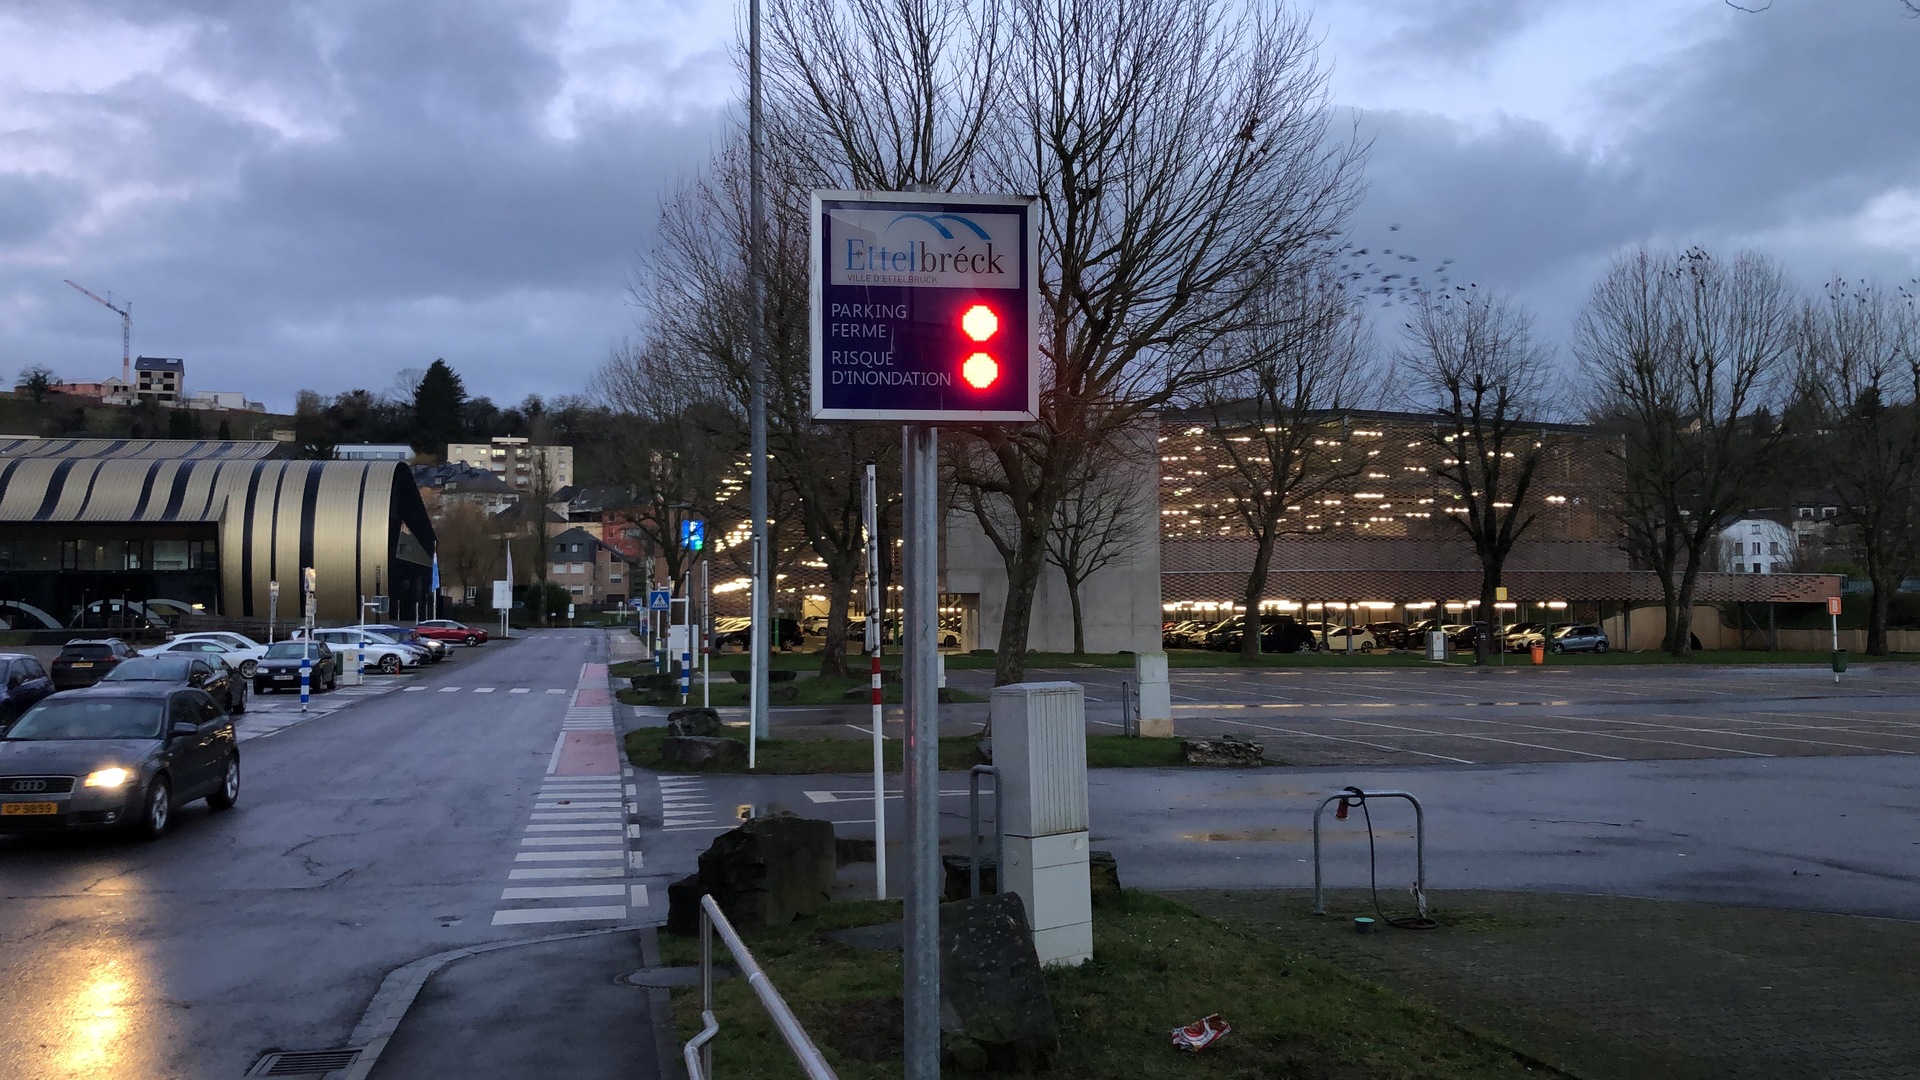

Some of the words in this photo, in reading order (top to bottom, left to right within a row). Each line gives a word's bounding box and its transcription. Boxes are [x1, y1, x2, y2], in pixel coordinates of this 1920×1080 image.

[845, 238, 1005, 274] Ettelbréck
[847, 274, 870, 283] VILLE
[831, 303, 907, 319] PARKING
[831, 323, 887, 338] FERME
[831, 350, 894, 369] RISQUE
[832, 370, 951, 386] D'INONDATION
